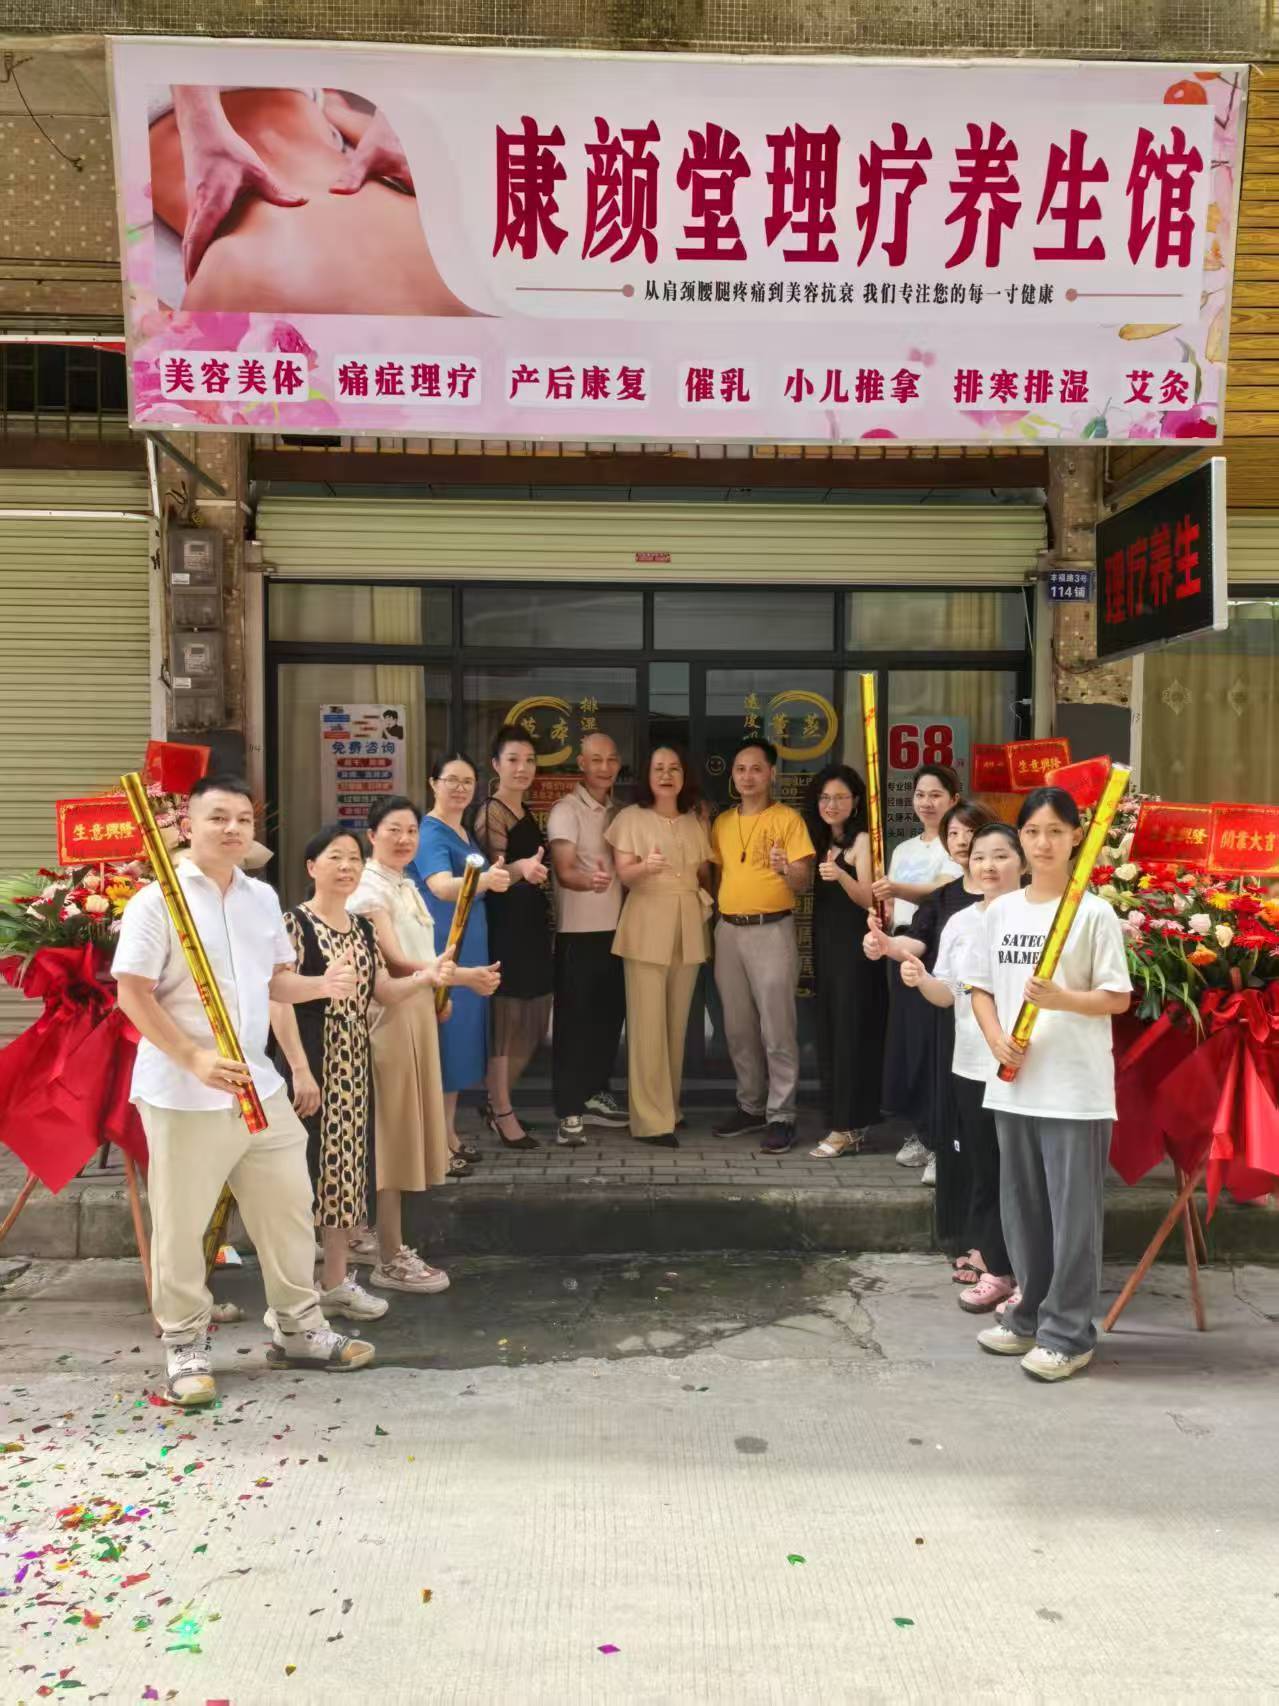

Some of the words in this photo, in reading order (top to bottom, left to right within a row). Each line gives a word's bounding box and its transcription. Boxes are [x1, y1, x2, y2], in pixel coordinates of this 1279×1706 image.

[492, 115, 1204, 269] 康颜堂理疗养生馆
[644, 280, 854, 303] 从肩颈腰腿疼痛到美容抗衰
[863, 282, 1054, 304] 我们专注您的每一寸健康
[165, 357, 304, 395] 美容美体
[338, 361, 477, 399] 痛症理疗
[510, 364, 646, 401] 产后康复
[685, 367, 751, 403] 催乳
[784, 368, 921, 404] 小儿推拿
[953, 368, 1089, 404] 排寒排湿
[1125, 369, 1189, 405] 艾灸
[1051, 586, 1086, 598] 114铺
[1105, 514, 1201, 624] 理疗养生
[332, 741, 395, 754] 免费咨询
[889, 724, 954, 770] 68
